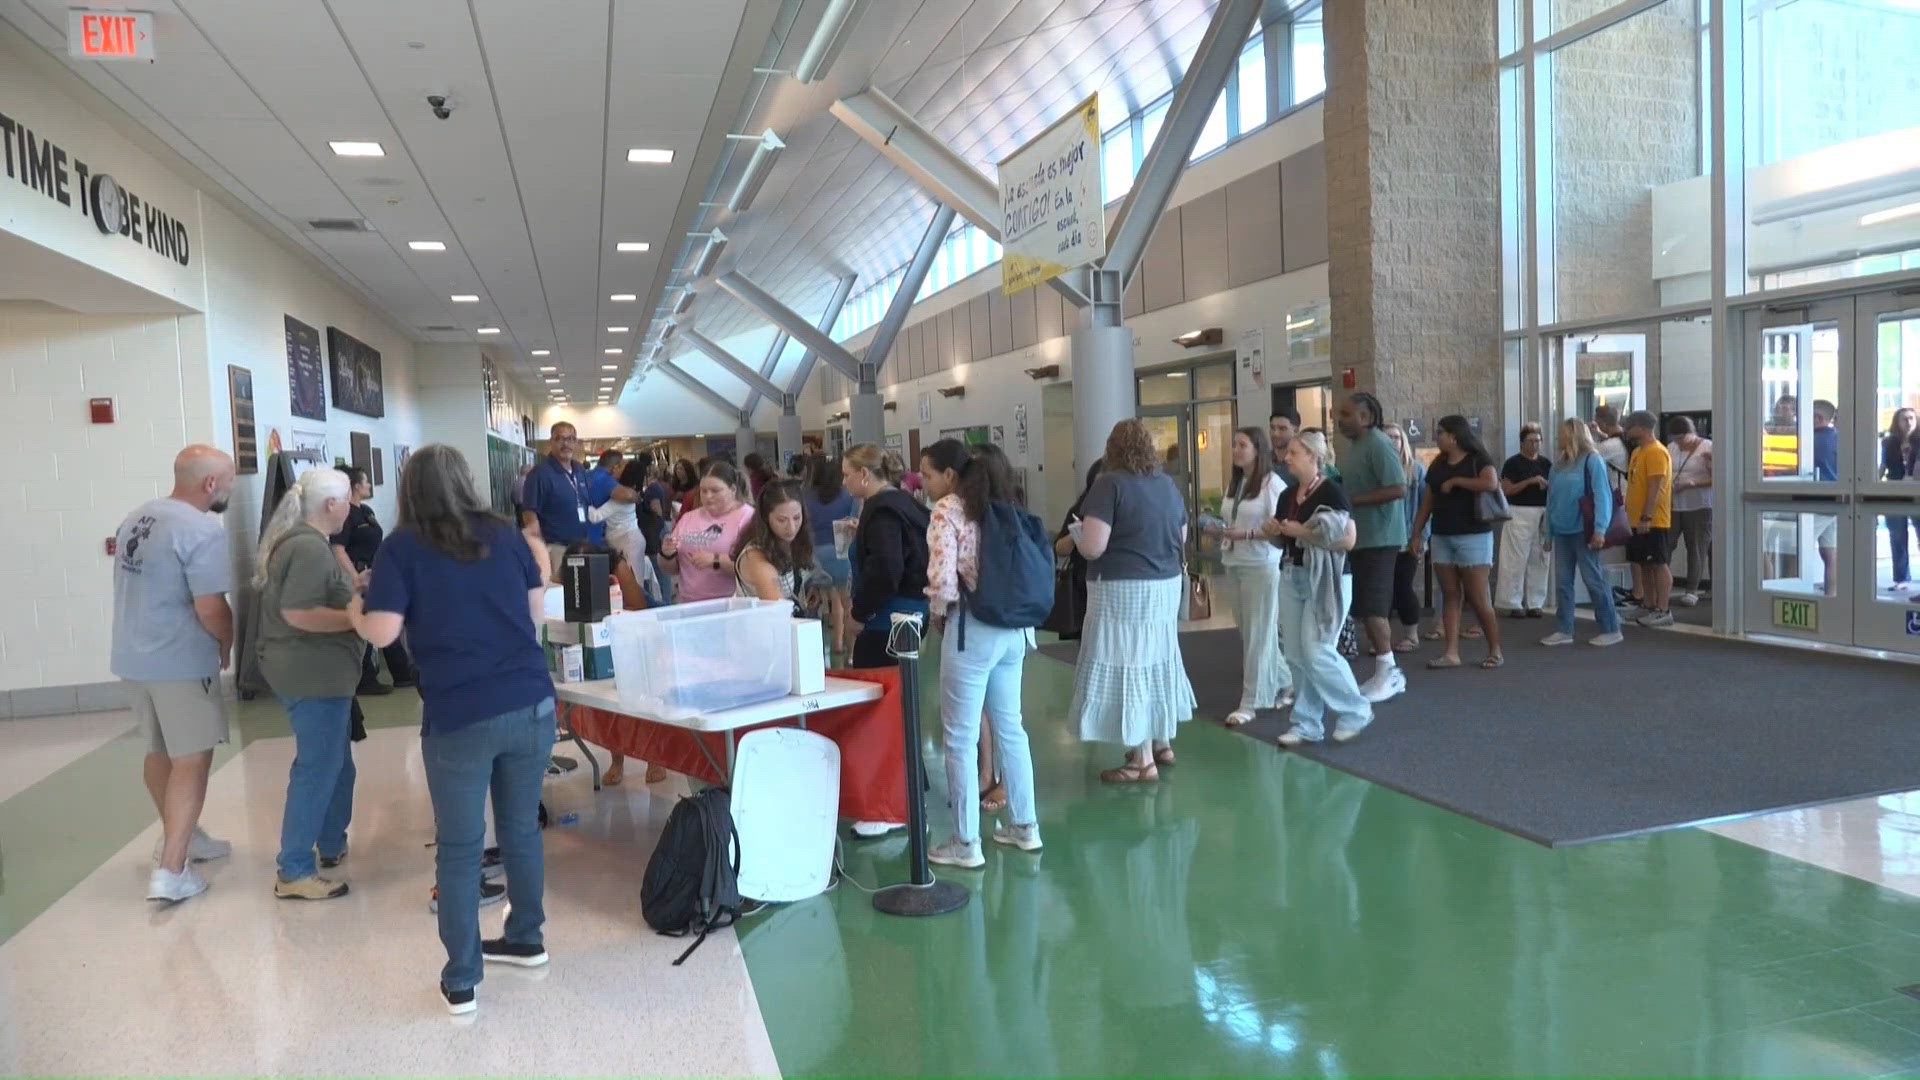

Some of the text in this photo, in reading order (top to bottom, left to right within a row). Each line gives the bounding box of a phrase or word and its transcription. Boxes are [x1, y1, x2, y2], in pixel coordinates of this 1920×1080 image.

[82, 15, 136, 56] EXIT
[0, 112, 71, 208] TIME
[144, 201, 189, 267] KIND
[1781, 601, 1810, 627] EXIT
